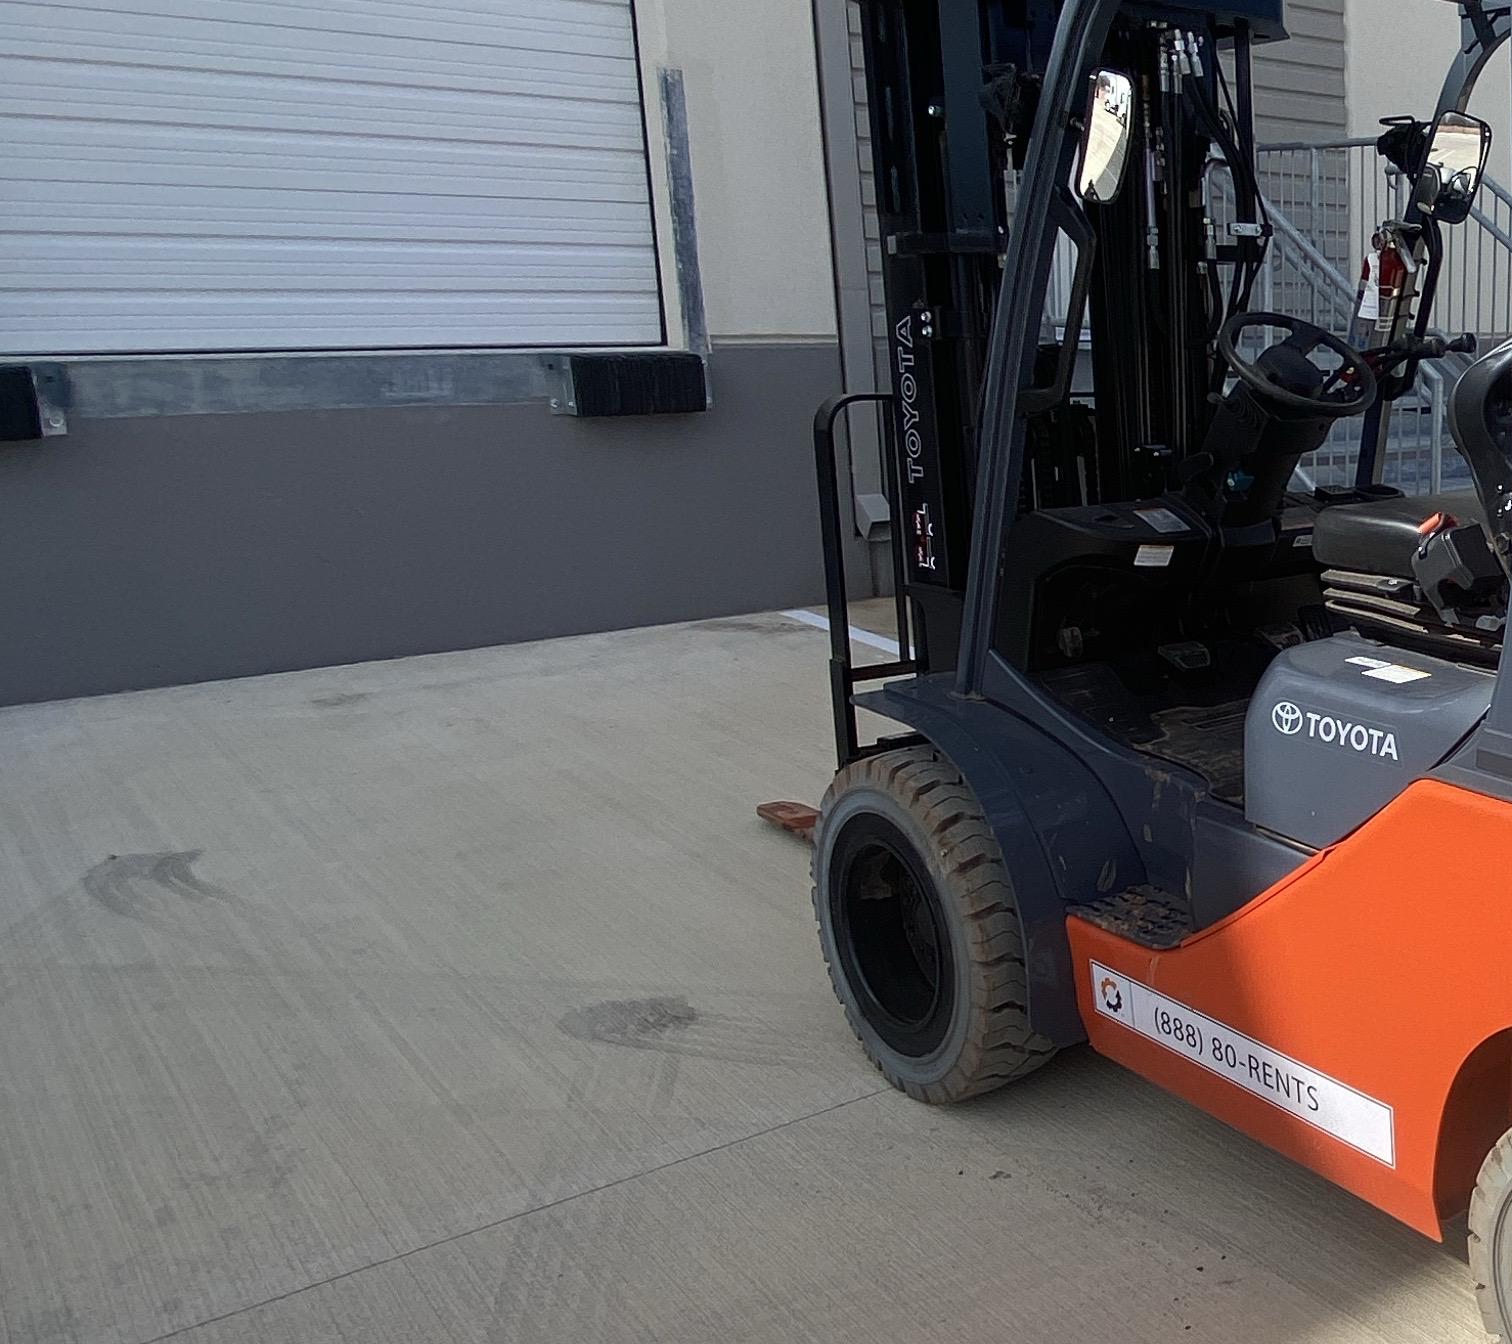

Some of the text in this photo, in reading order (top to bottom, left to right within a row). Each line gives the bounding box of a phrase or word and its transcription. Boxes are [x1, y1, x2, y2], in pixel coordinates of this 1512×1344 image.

[895, 314, 924, 485] TOYOTA
[1306, 712, 1398, 761] TOYOTA
[1154, 1007, 1319, 1111] (888) 80-RENTS
